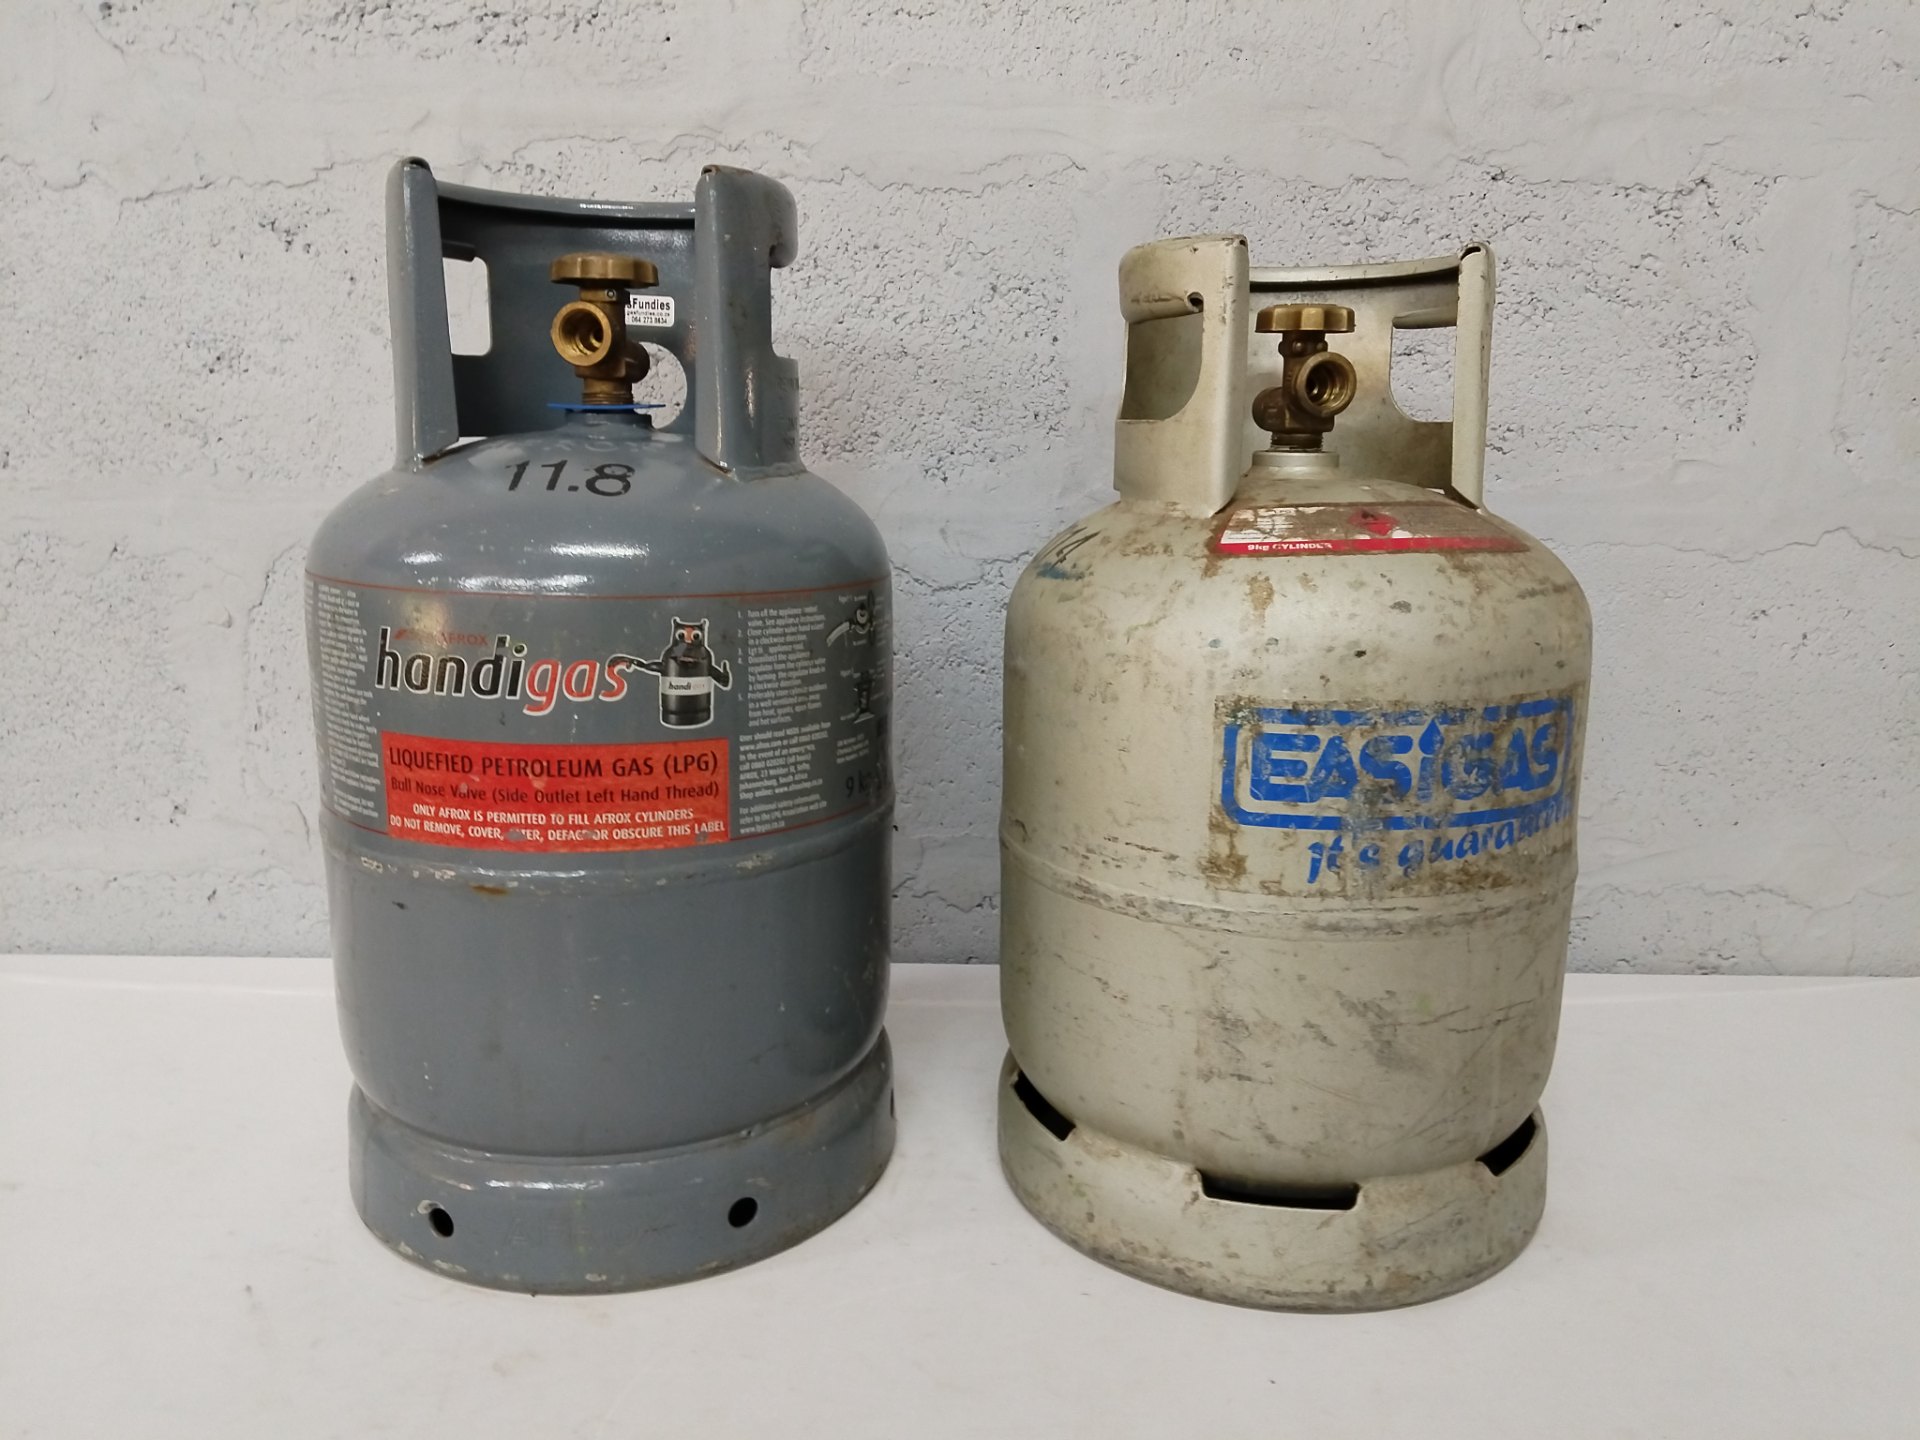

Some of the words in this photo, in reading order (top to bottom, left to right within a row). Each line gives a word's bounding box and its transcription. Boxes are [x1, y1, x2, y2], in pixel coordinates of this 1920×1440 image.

[505, 459, 636, 497] 11.8
[375, 626, 628, 717] handigas
[389, 747, 473, 774] LIQUEFIED
[482, 756, 603, 778] PETROLEUM
[612, 757, 654, 777] GAS
[663, 750, 718, 779] (LPG)
[391, 776, 411, 792] Bull
[416, 780, 445, 796] Nose
[450, 783, 486, 800] Valve
[492, 787, 528, 804] (Side
[534, 788, 579, 804] Outlet
[587, 788, 614, 803] Left
[621, 785, 660, 801] Hand
[665, 781, 719, 799] Thread)
[390, 814, 401, 826] DO
[404, 817, 421, 830] NOT
[424, 822, 465, 838] REMOVE,
[468, 826, 504, 840] COVER,
[612, 826, 664, 840] OBSCURE
[667, 823, 691, 836] THIS
[695, 820, 725, 834] LABEL
[413, 803, 435, 816] ONLY
[438, 806, 470, 821] AFROX
[474, 810, 483, 822] IS
[486, 811, 546, 825] PERMITTED
[549, 814, 565, 825] TO
[568, 813, 590, 825] FILL
[593, 811, 631, 825] AFROX
[635, 808, 694, 823] CYLINDERS
